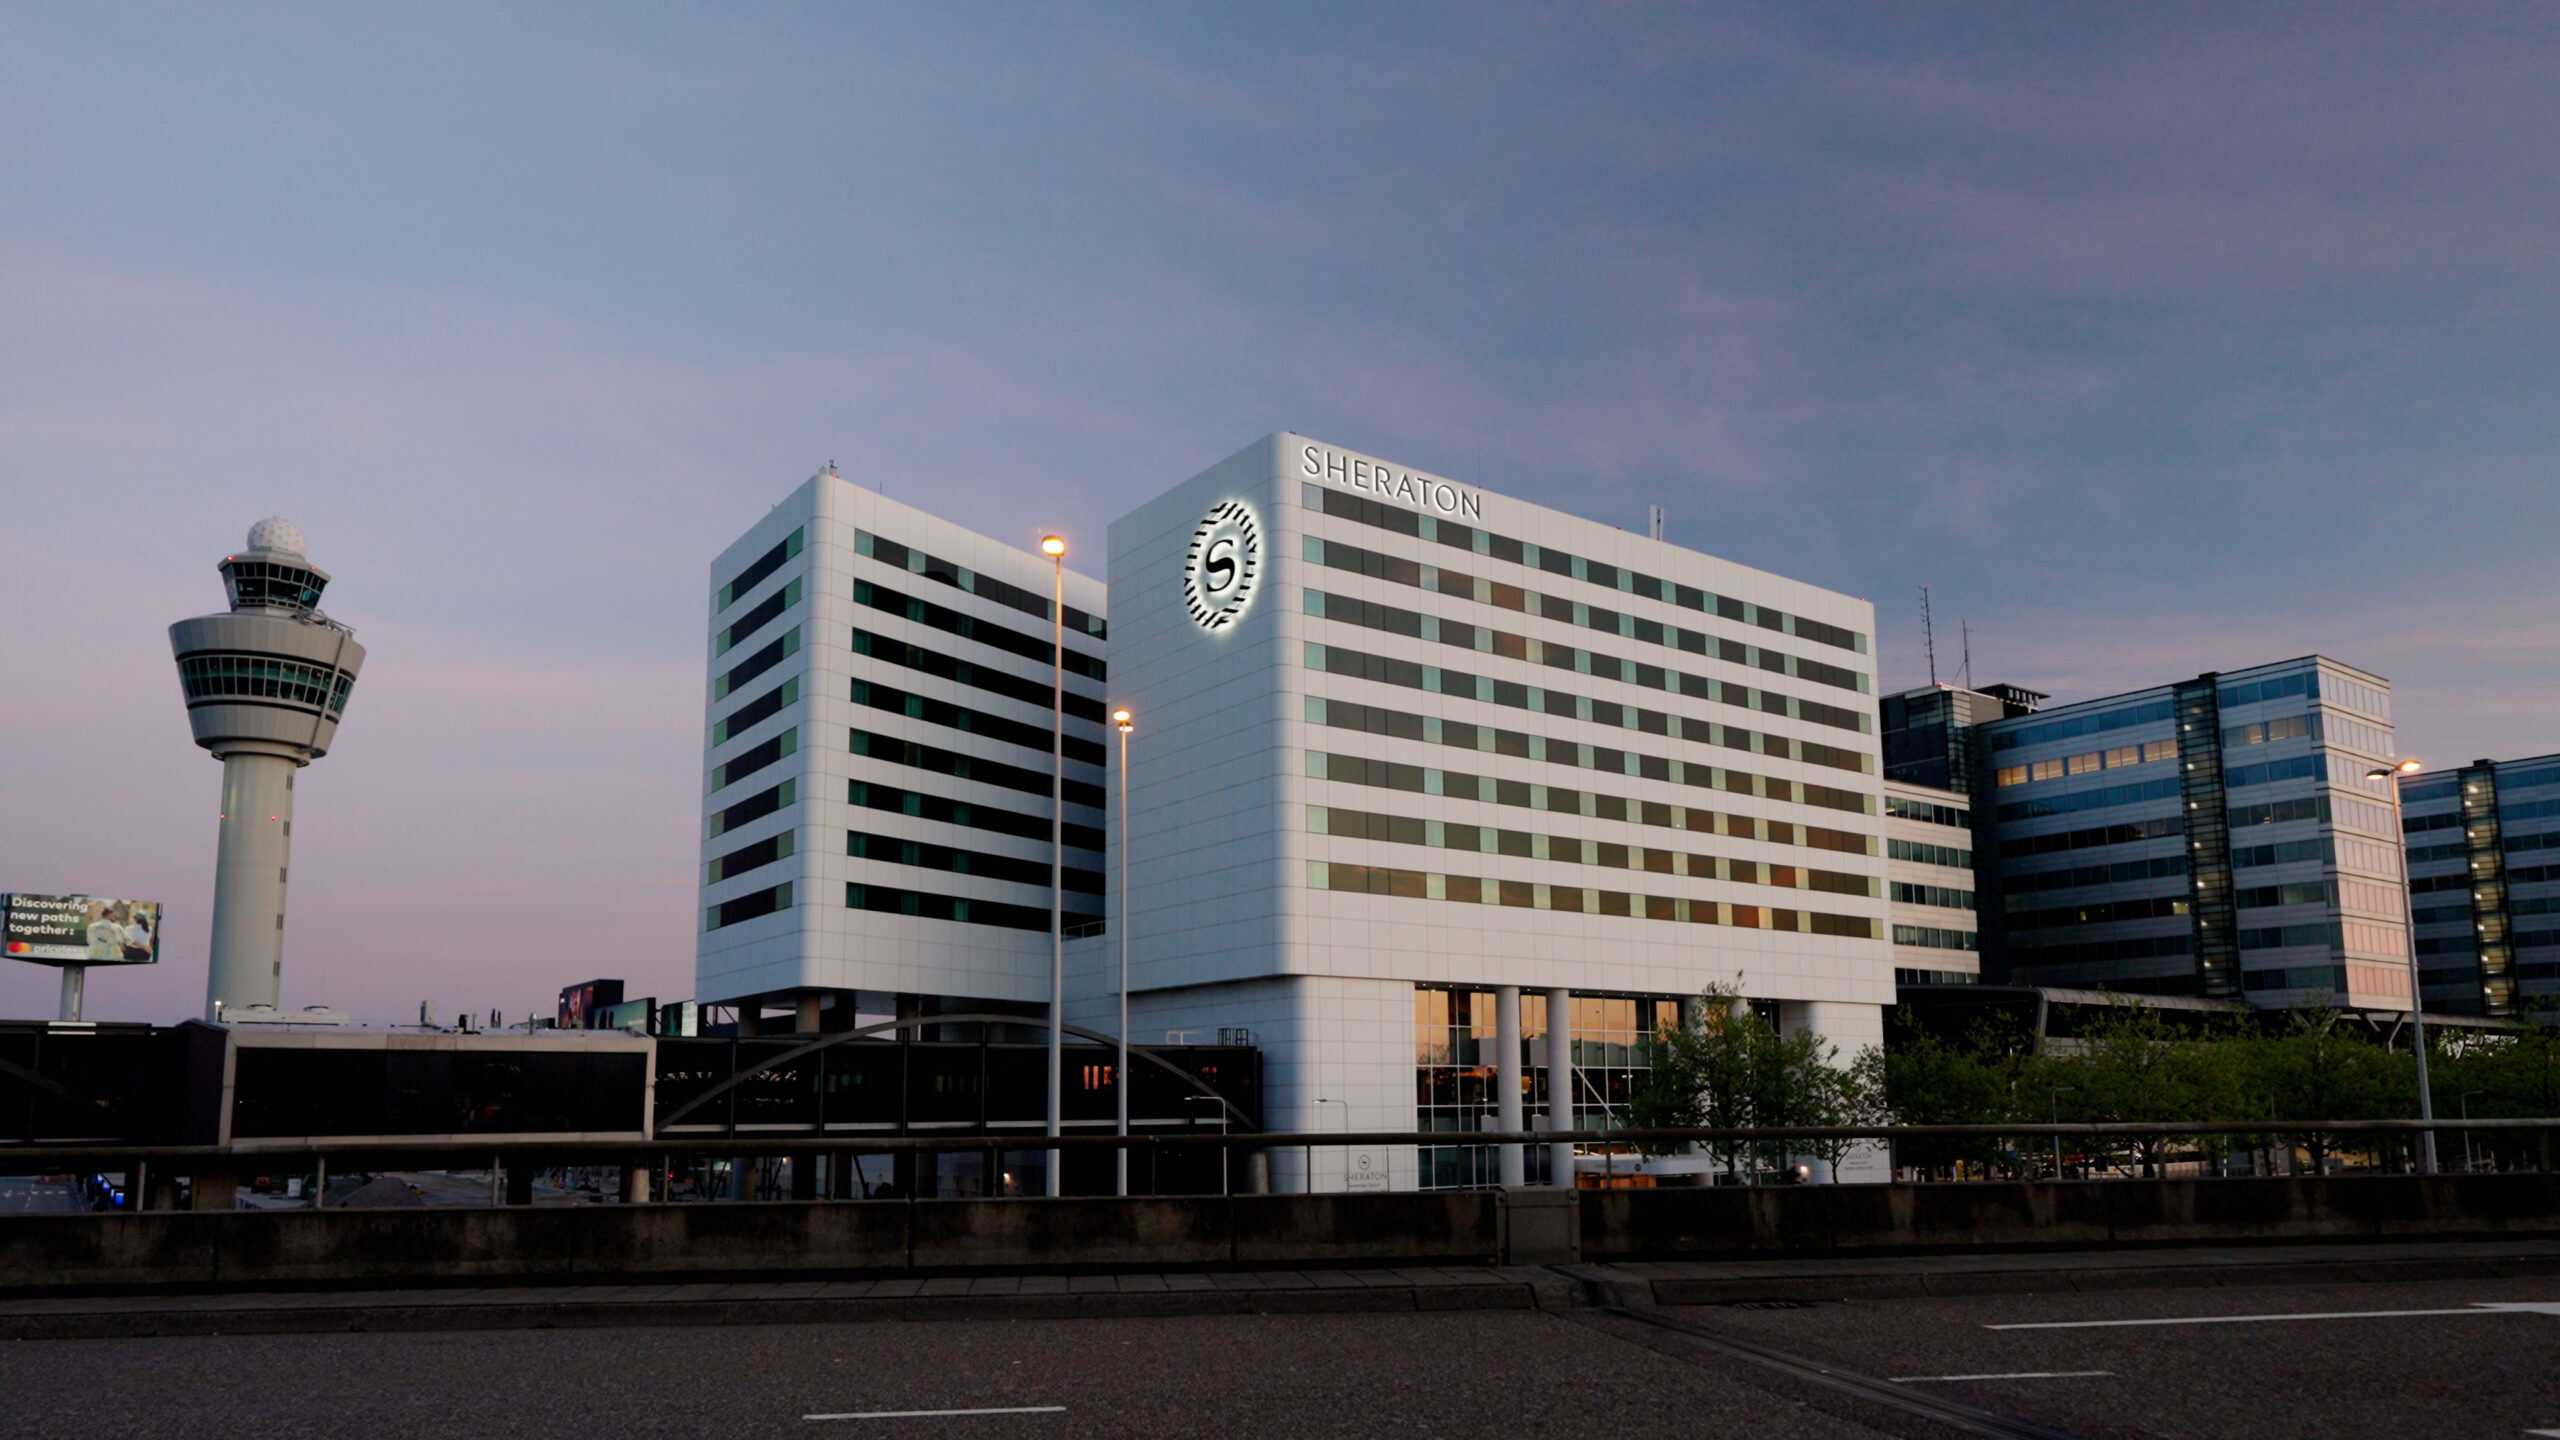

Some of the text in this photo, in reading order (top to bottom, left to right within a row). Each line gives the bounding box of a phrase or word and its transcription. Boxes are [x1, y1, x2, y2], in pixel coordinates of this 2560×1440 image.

[1302, 445, 1482, 521] SHERATON
[1205, 539, 1237, 593] S
[12, 897, 88, 913] Discovering
[10, 912, 80, 923] new paths
[1343, 1172, 1387, 1182] SHERATON
